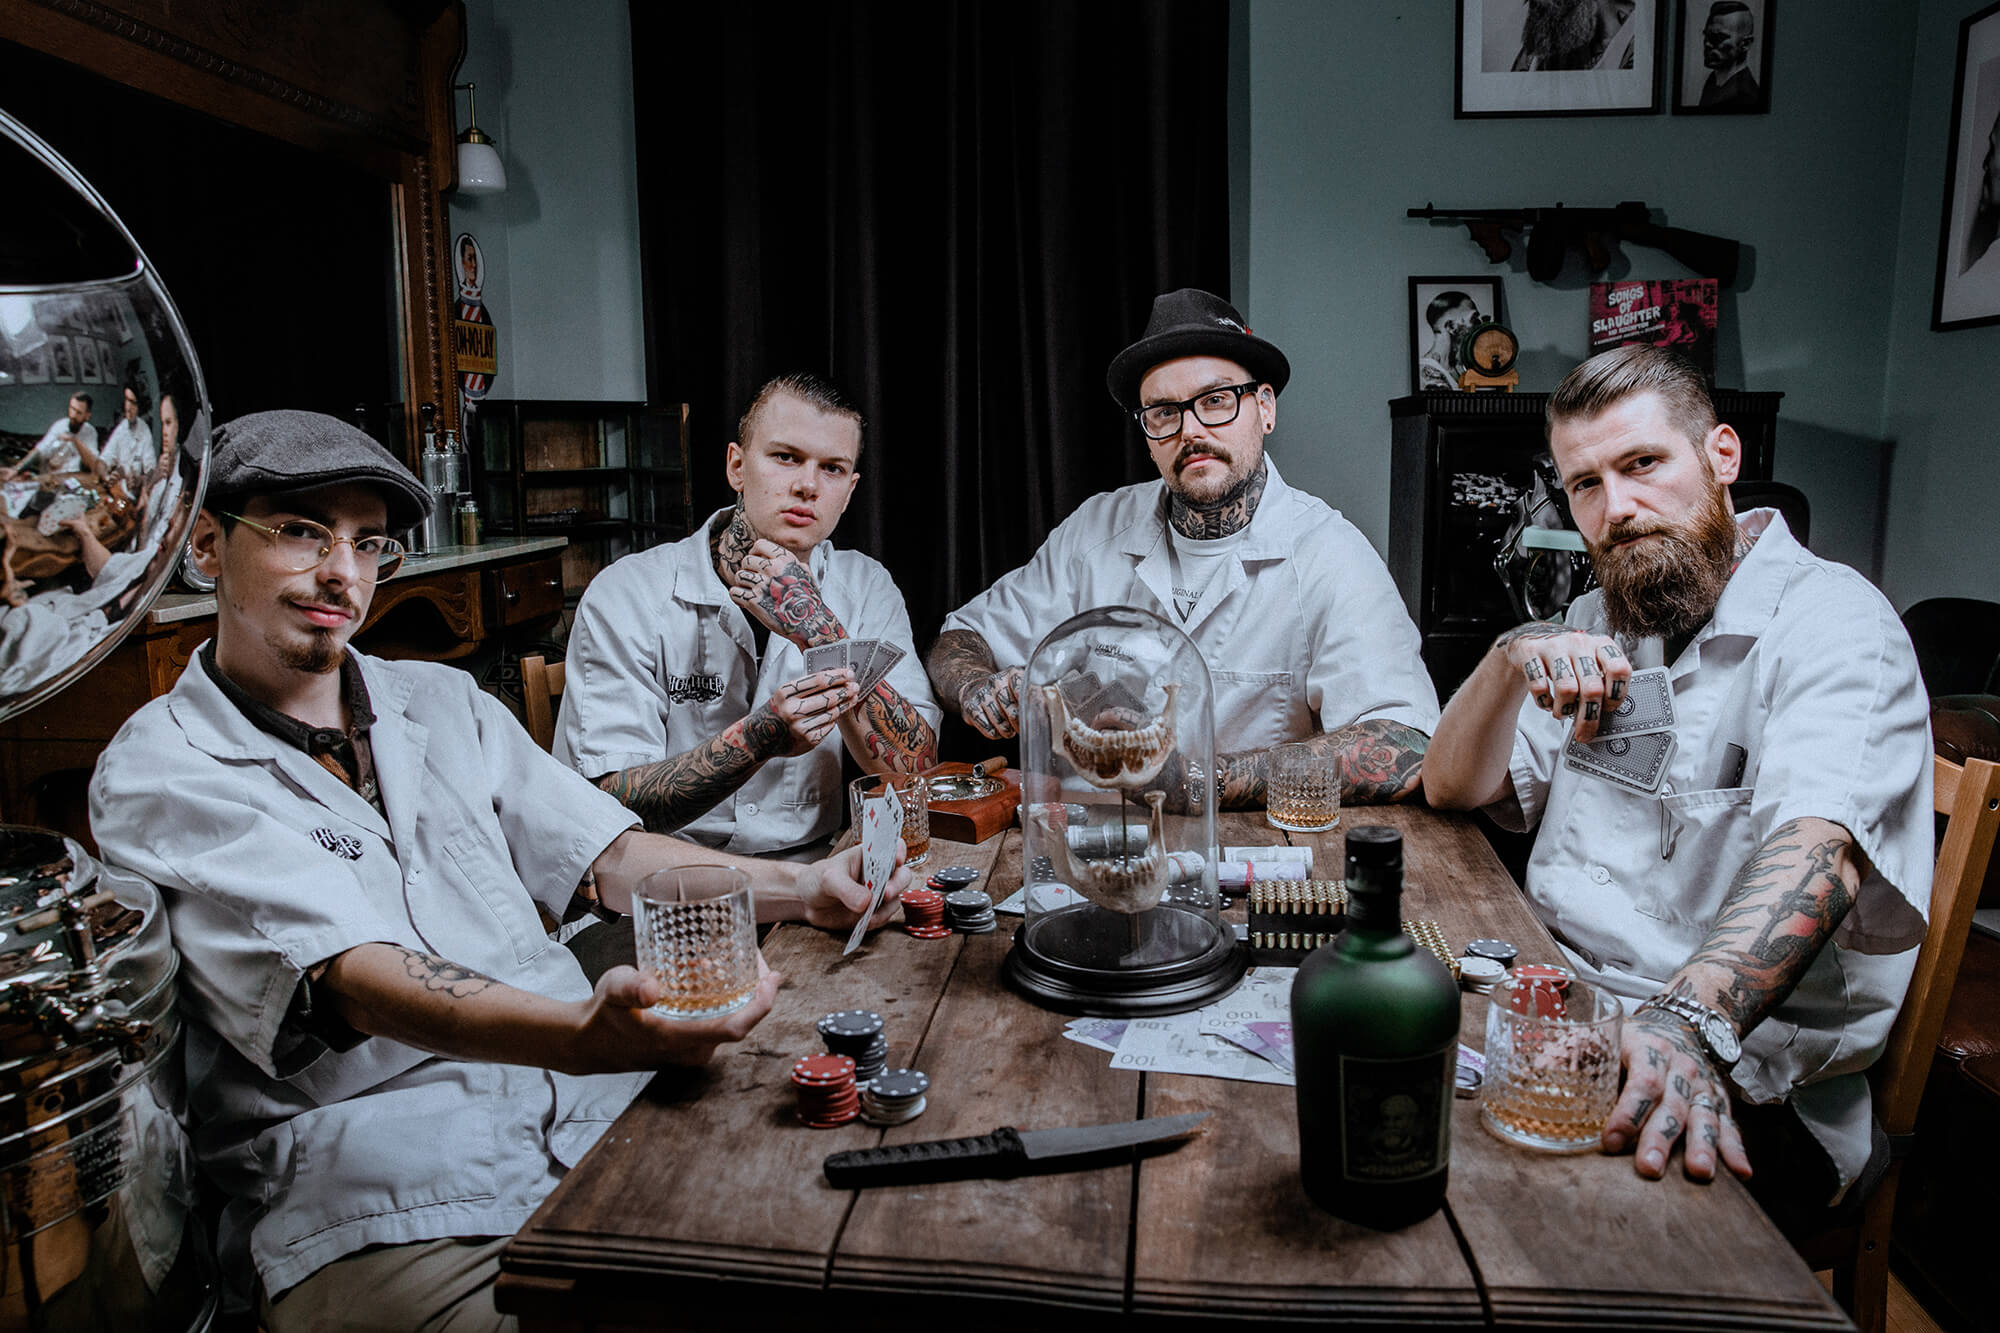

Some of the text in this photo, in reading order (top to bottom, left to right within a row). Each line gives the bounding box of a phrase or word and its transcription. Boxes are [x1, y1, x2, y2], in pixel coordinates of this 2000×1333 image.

[1608, 285, 1645, 307] SONGS
[1619, 300, 1634, 315] OF
[1592, 305, 1662, 334] SLAUGHTER
